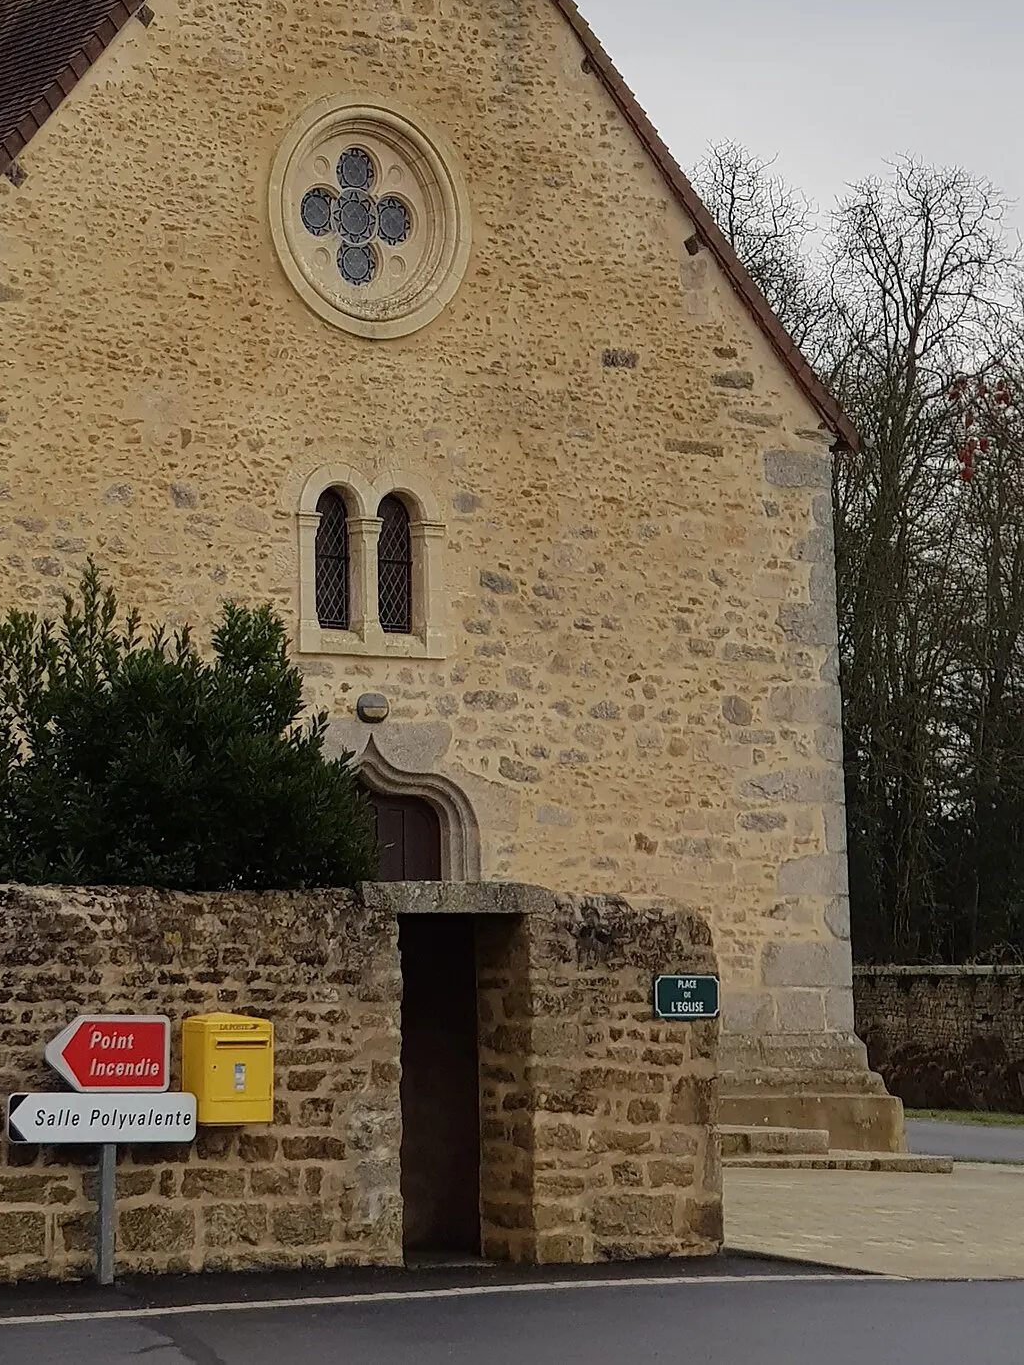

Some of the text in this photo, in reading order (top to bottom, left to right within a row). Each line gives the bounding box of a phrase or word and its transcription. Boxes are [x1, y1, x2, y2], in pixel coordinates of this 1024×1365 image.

[677, 979, 697, 989] PLACE
[671, 1001, 704, 1012] L'EGLISE
[89, 1031, 134, 1049] Point
[89, 1058, 160, 1076] Incendie
[34, 1109, 192, 1130] Salle Polyvalente
